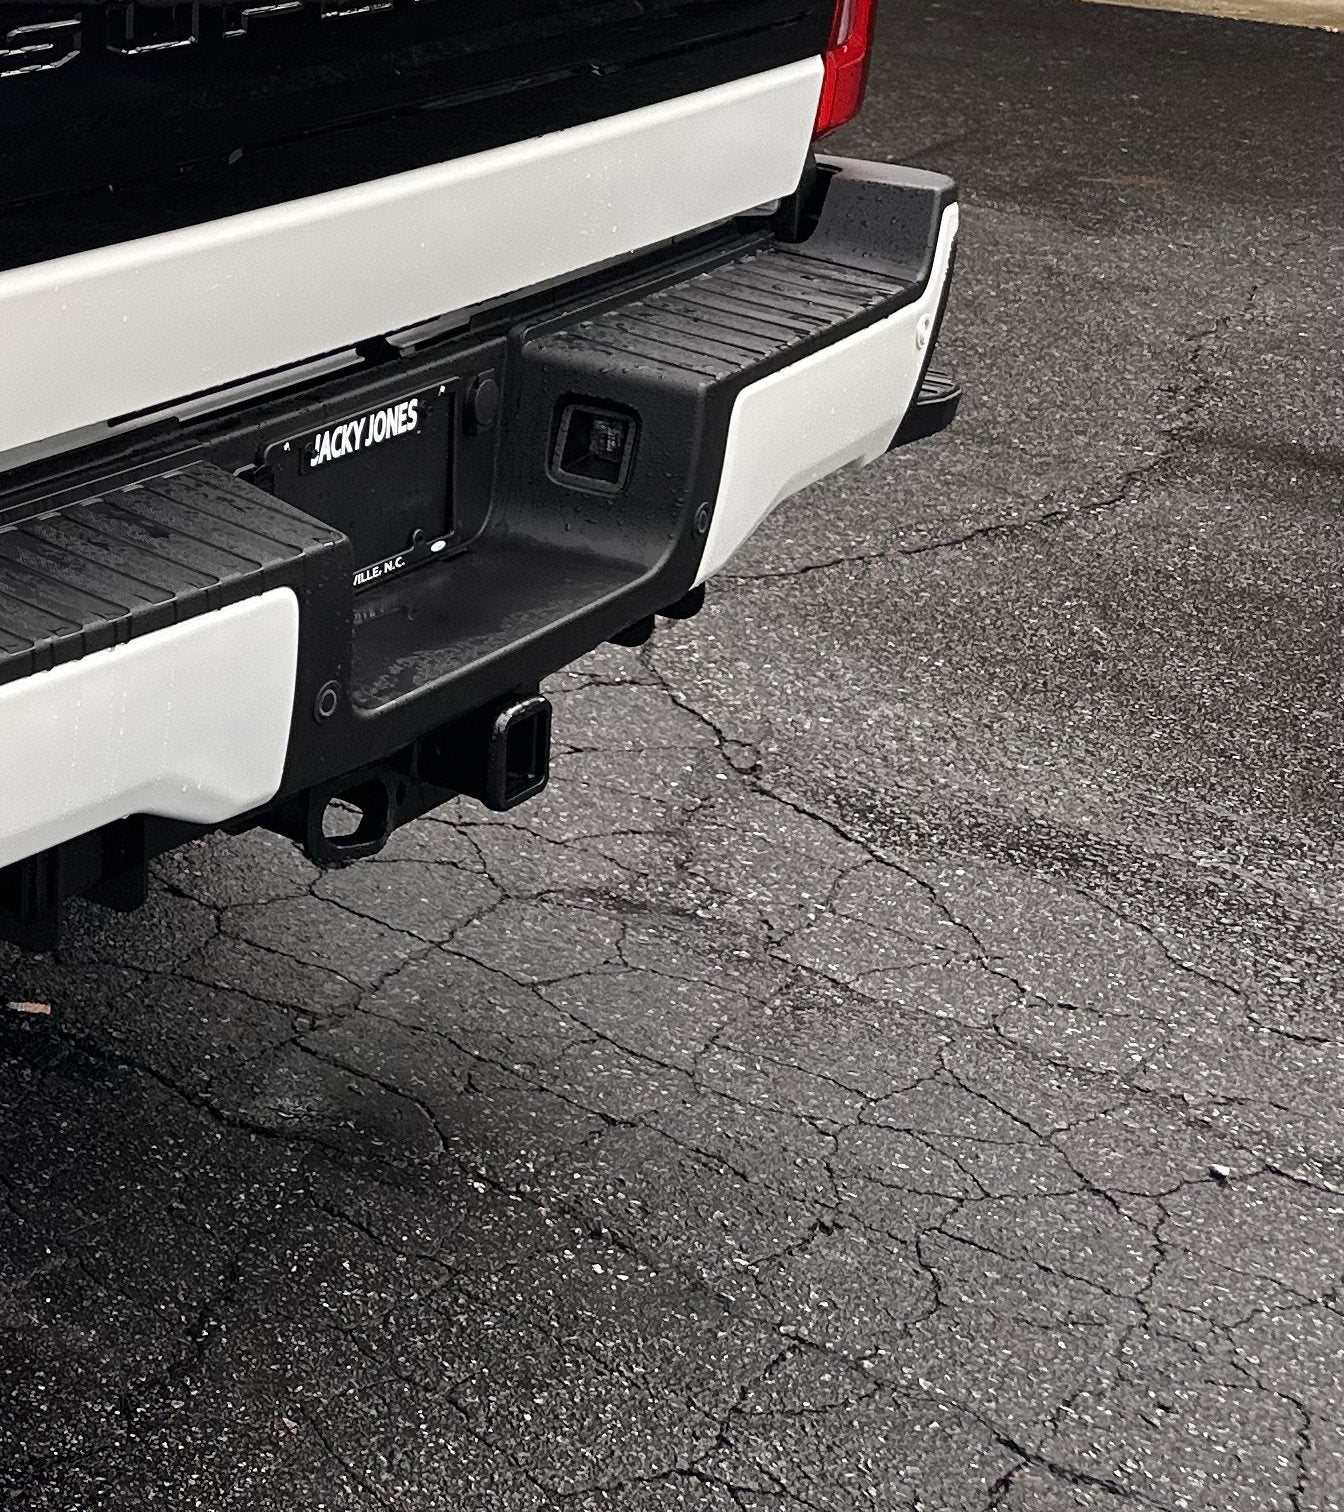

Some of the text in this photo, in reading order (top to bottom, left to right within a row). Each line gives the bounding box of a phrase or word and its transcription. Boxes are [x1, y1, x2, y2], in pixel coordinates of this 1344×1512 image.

[309, 398, 419, 467] JACKY JONES
[383, 555, 406, 574] N.C.
